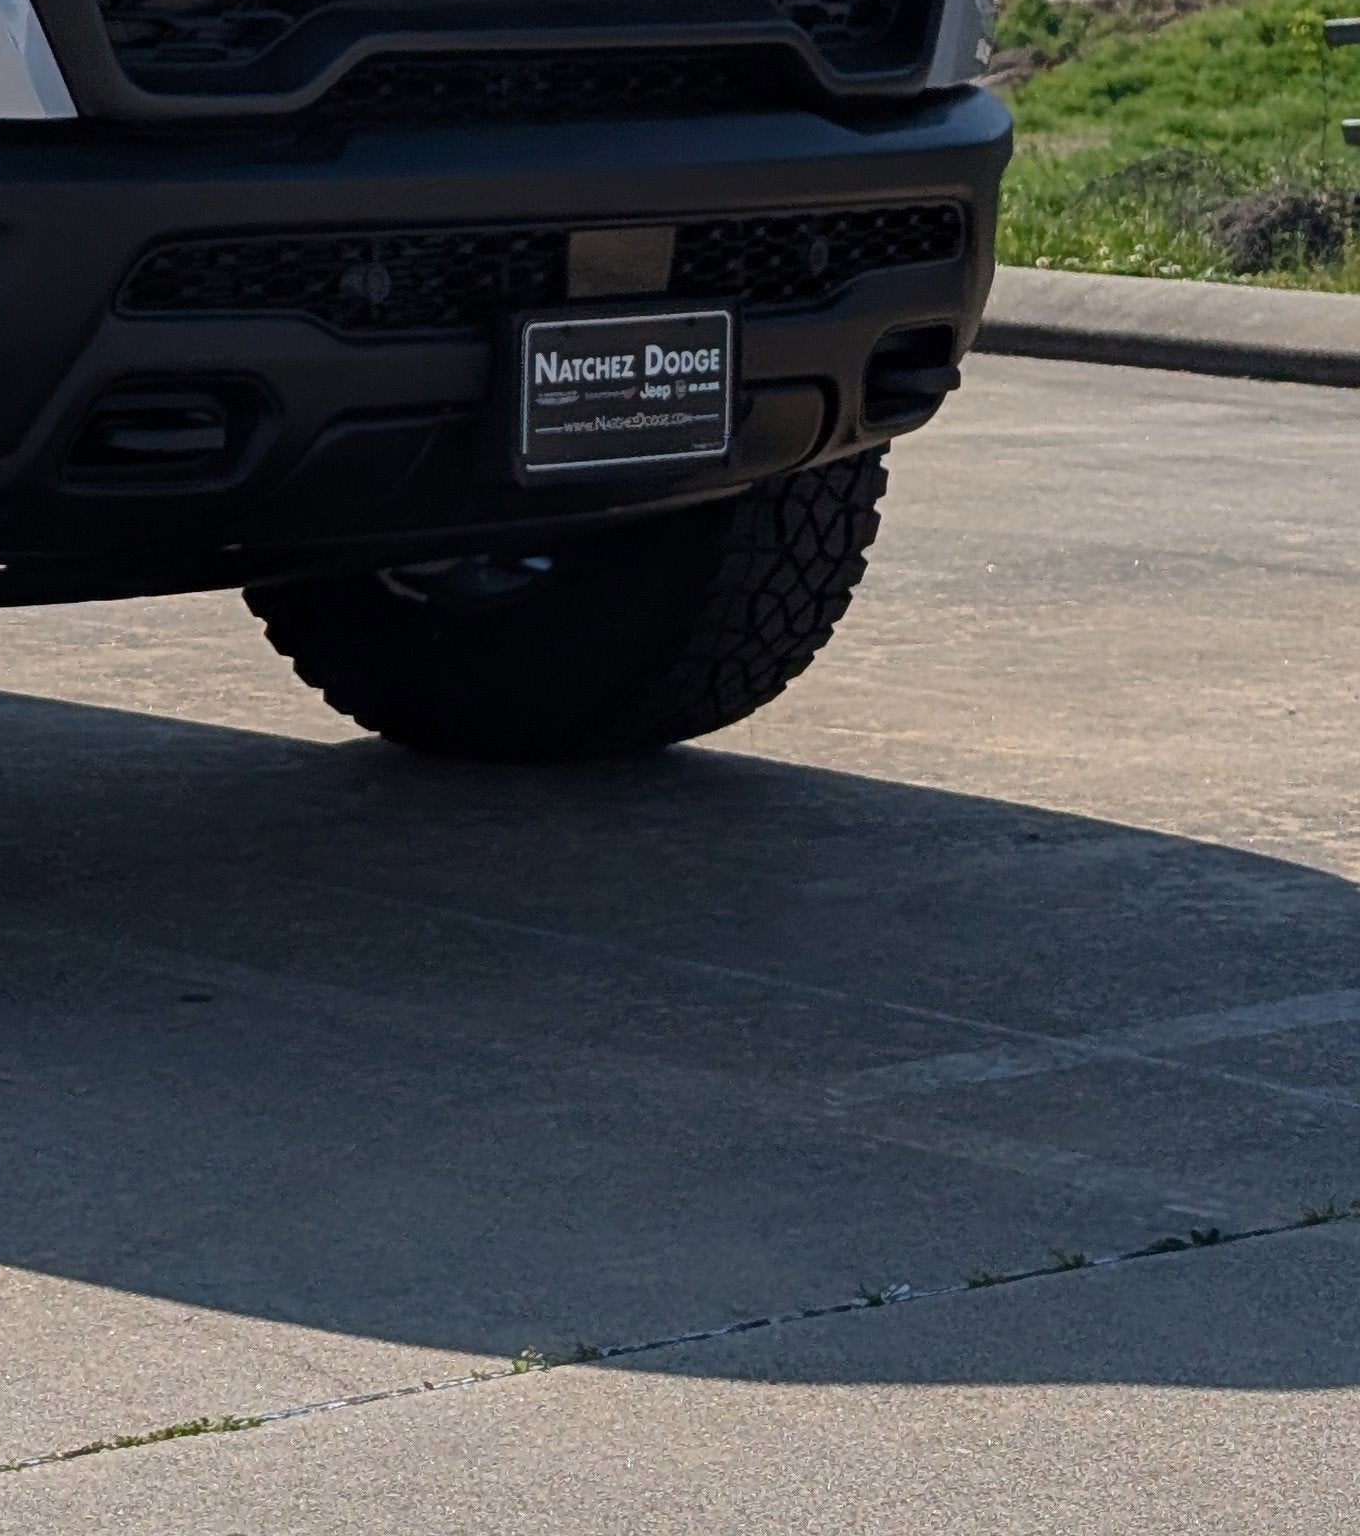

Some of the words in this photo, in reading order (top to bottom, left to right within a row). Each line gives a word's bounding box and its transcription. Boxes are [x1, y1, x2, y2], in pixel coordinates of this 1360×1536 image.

[535, 351, 636, 384] NATCHEZ
[645, 345, 720, 376] DODGE
[640, 382, 671, 400] Jeep
